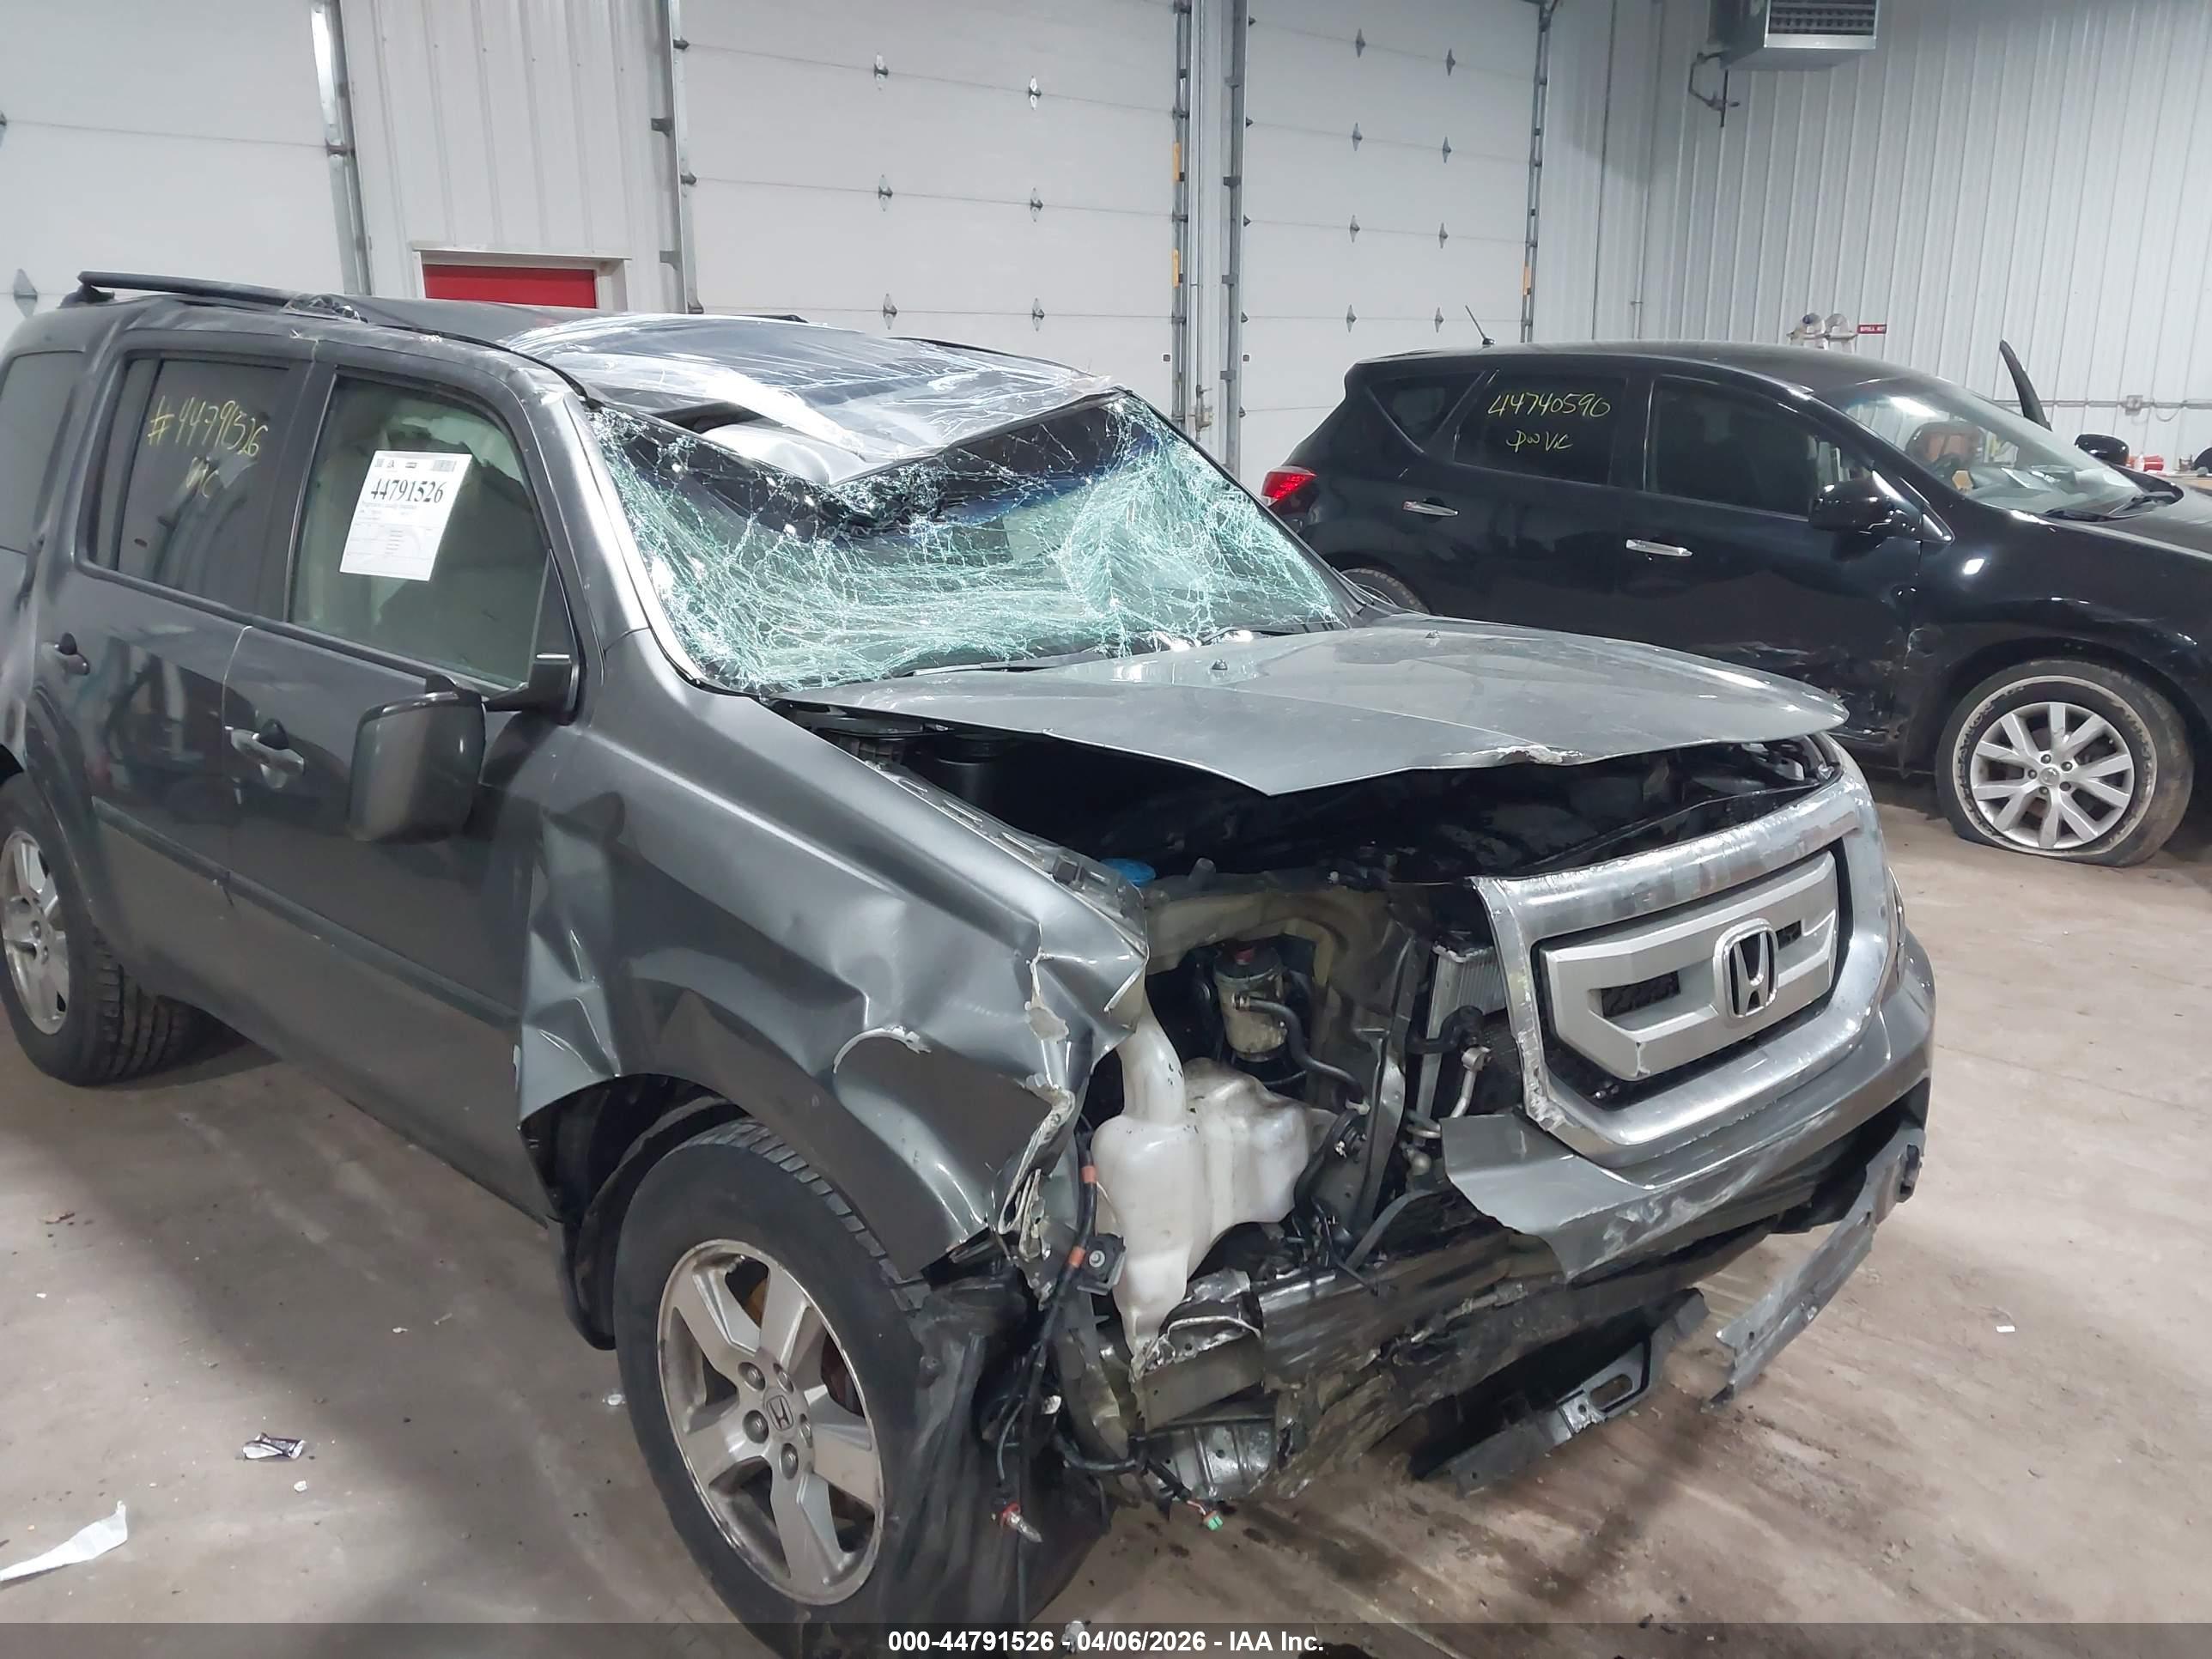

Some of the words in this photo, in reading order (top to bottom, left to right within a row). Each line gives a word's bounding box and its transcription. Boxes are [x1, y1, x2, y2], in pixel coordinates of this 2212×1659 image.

[1487, 392, 1611, 417] 44740590
[148, 396, 269, 457] #44791526
[370, 477, 447, 503] 44791526
